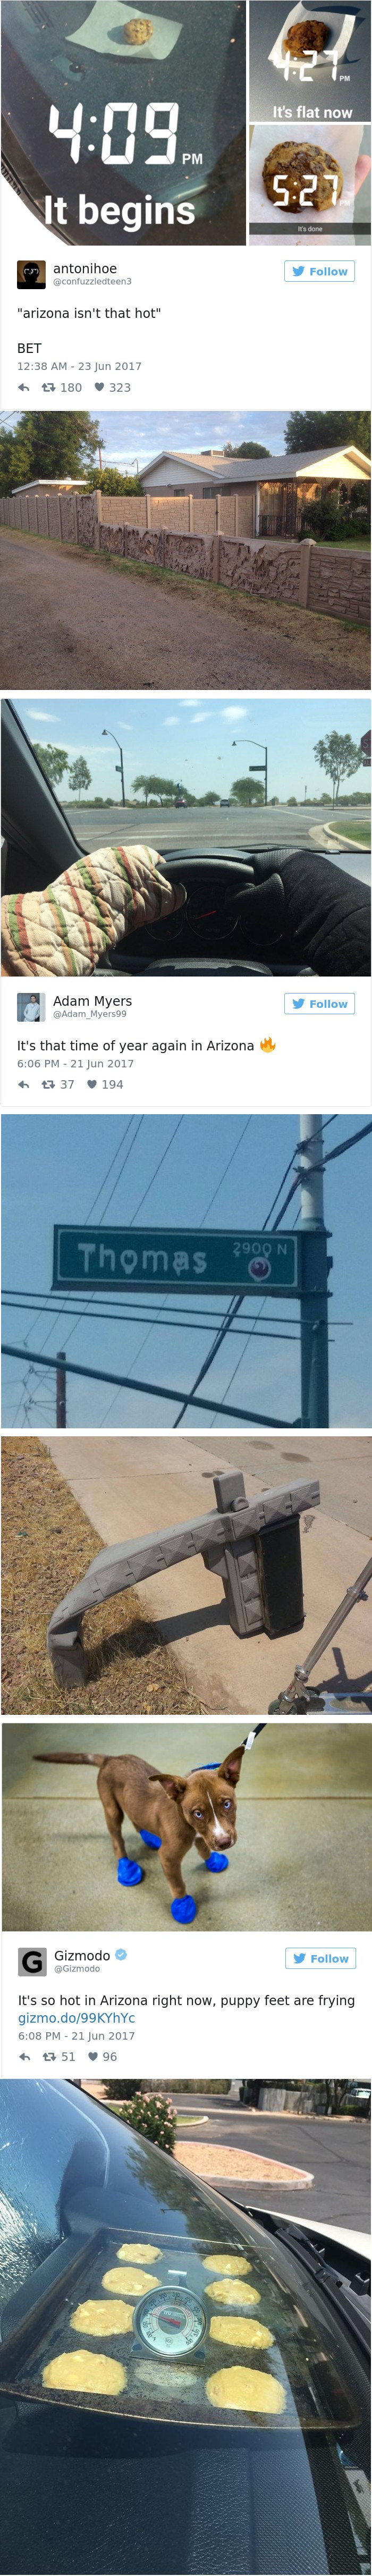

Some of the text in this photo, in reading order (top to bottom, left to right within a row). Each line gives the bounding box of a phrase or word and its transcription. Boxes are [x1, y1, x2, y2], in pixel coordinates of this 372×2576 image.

[78, 1243, 207, 1275] Thomas
[233, 1242, 287, 1256] 2900 N
